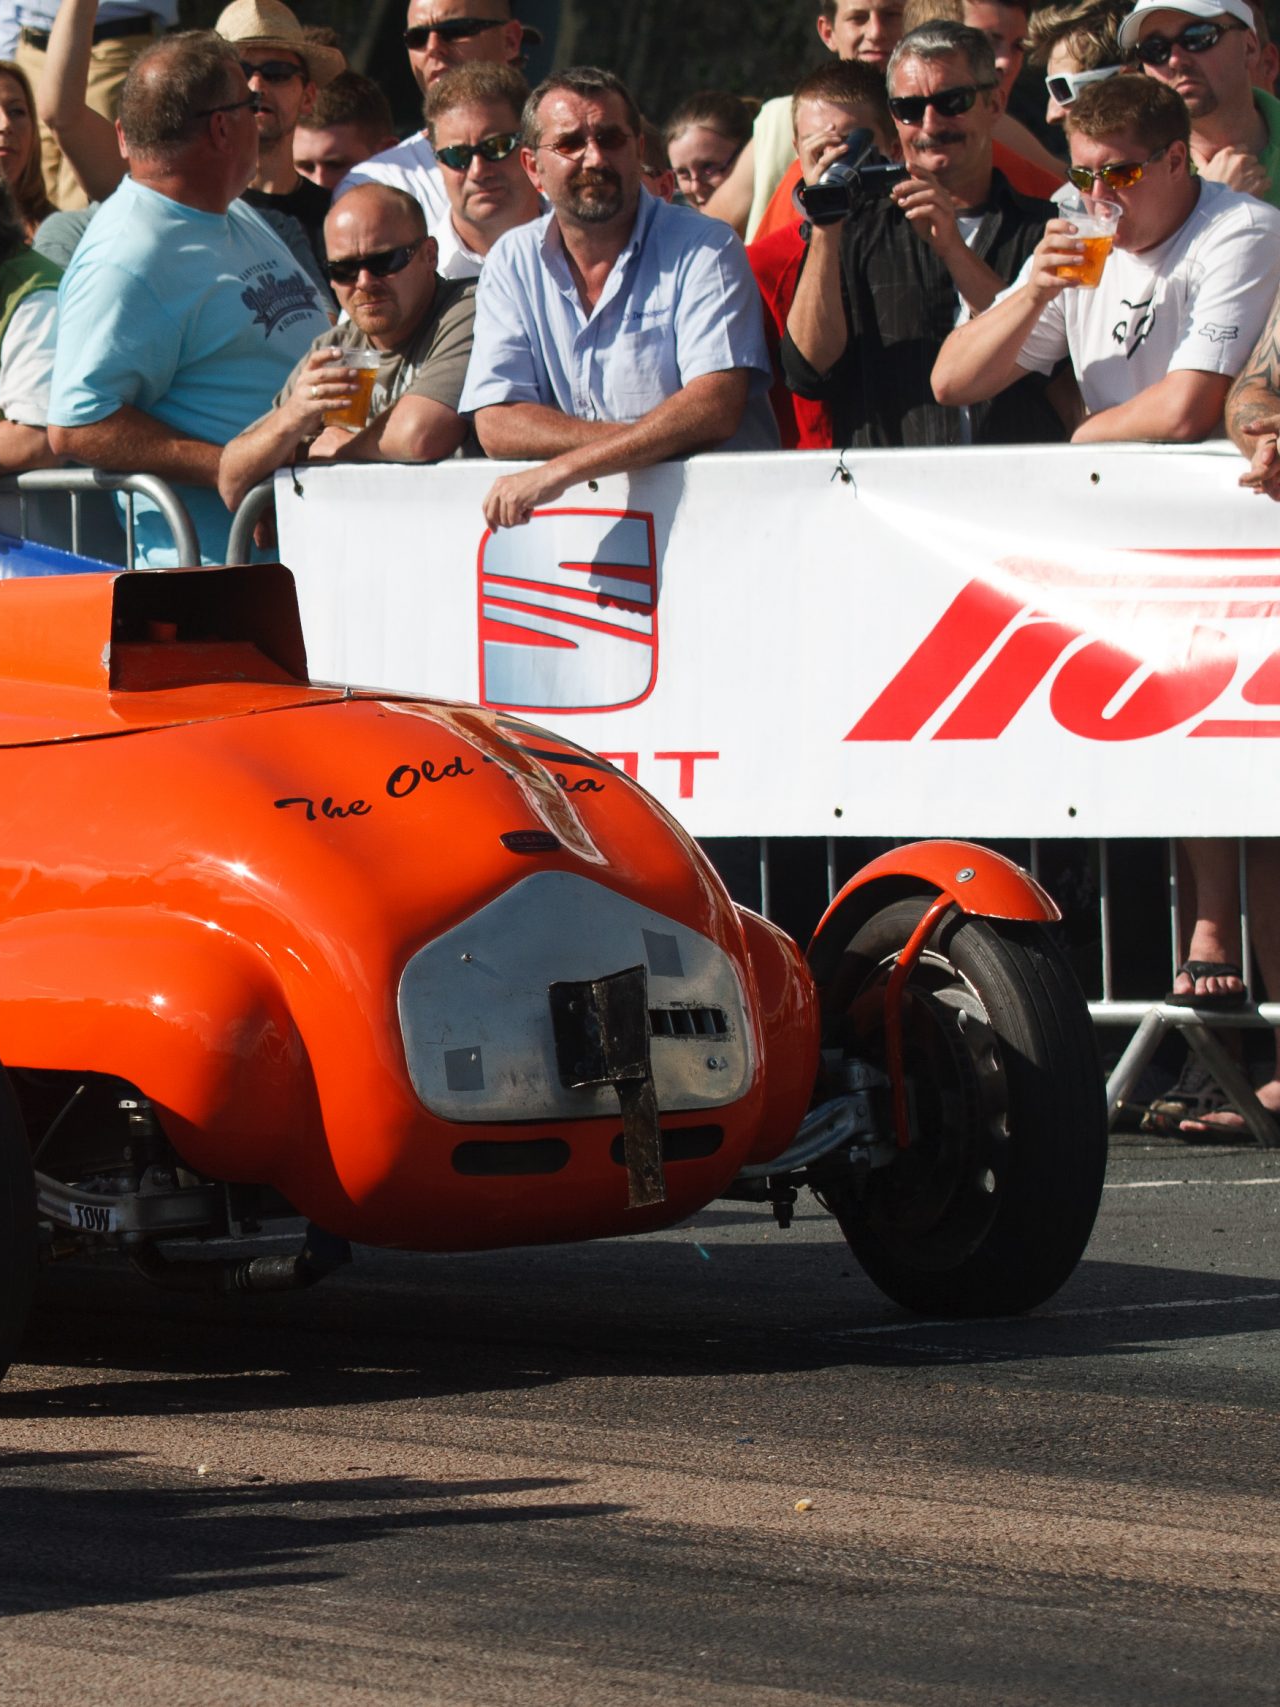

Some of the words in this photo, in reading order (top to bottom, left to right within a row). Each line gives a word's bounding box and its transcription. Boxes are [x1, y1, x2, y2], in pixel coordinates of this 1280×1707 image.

[273, 797, 373, 821] The
[385, 756, 474, 798] Old
[74, 1204, 111, 1232] TOW
